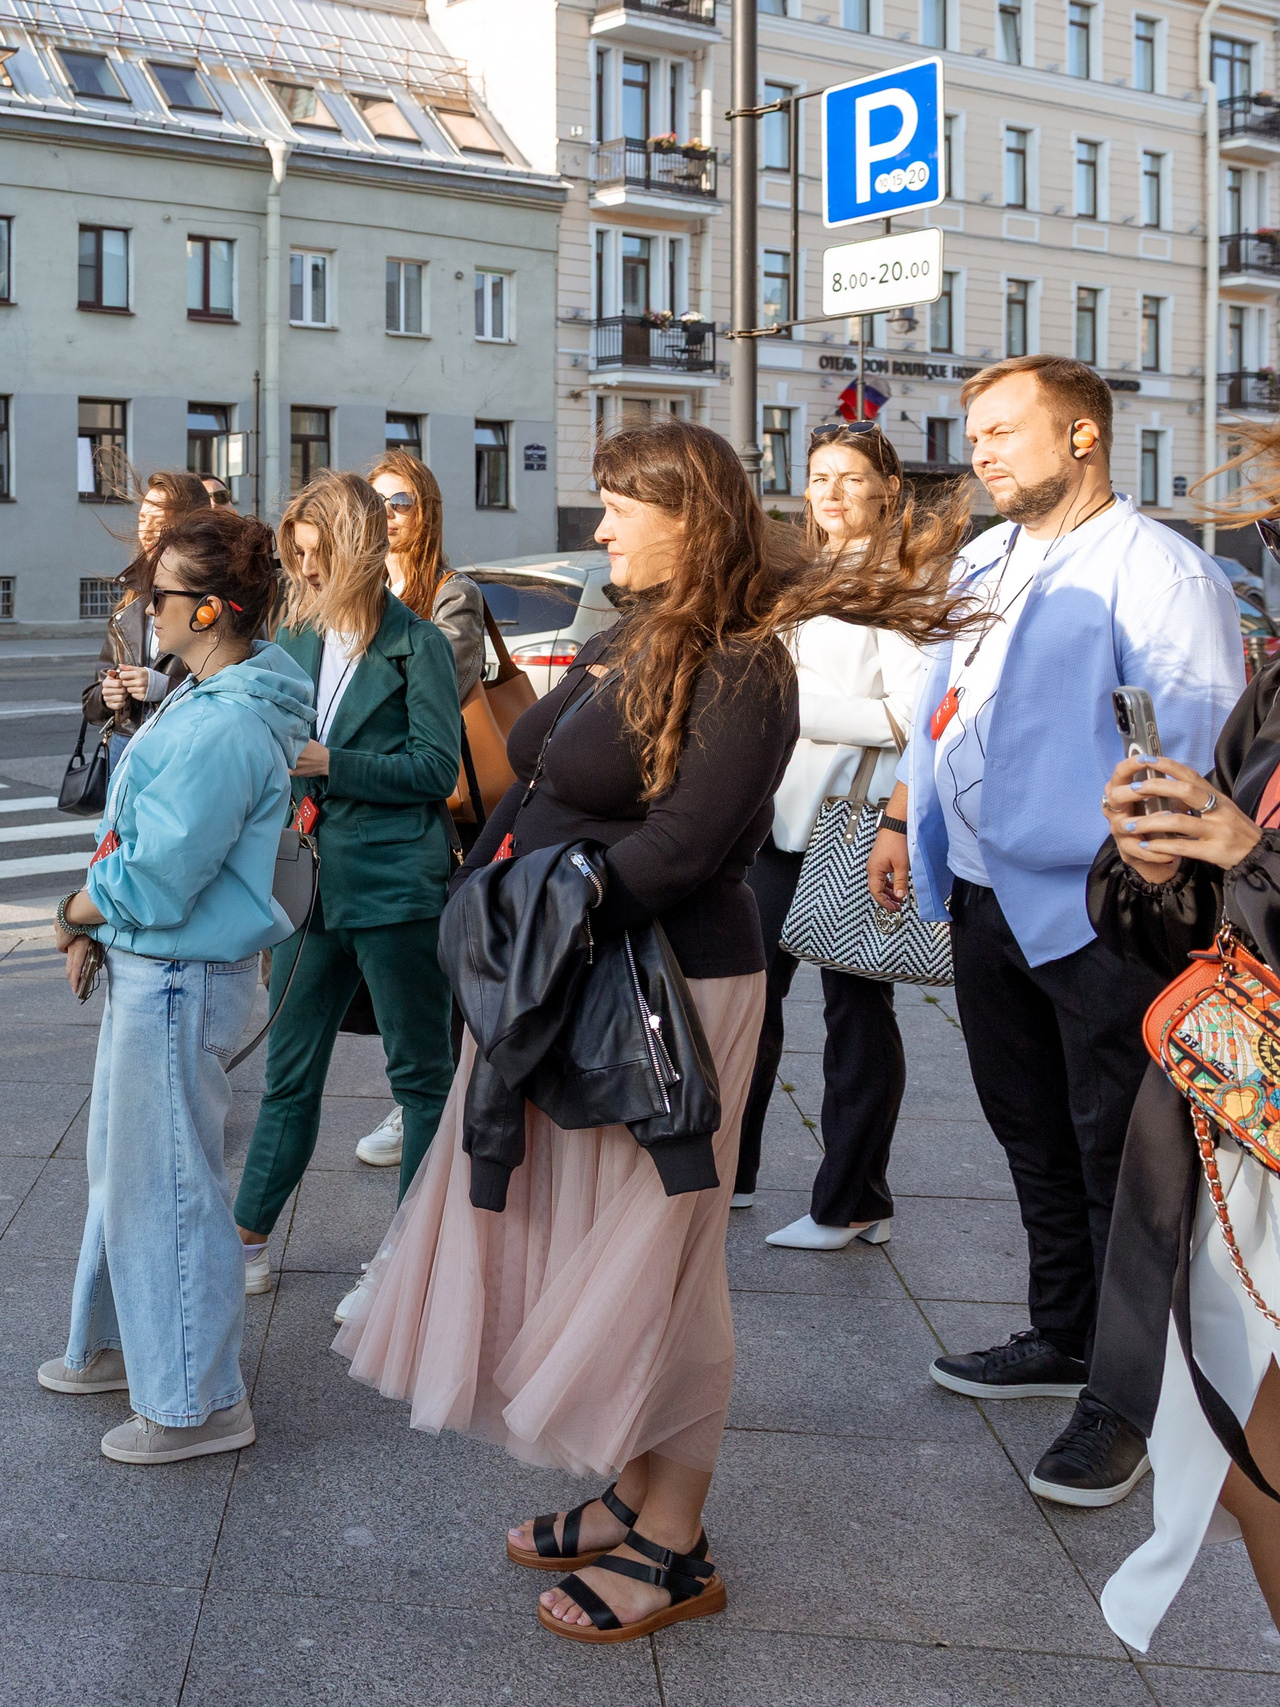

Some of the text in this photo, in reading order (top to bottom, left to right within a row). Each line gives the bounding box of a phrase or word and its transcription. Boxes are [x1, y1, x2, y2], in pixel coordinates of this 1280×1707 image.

[855, 87, 919, 205] P
[892, 173, 903, 187] 15
[908, 167, 927, 185] 20
[831, 260, 931, 293] 8.00-20.00
[892, 361, 947, 380] BOUTIQUE
